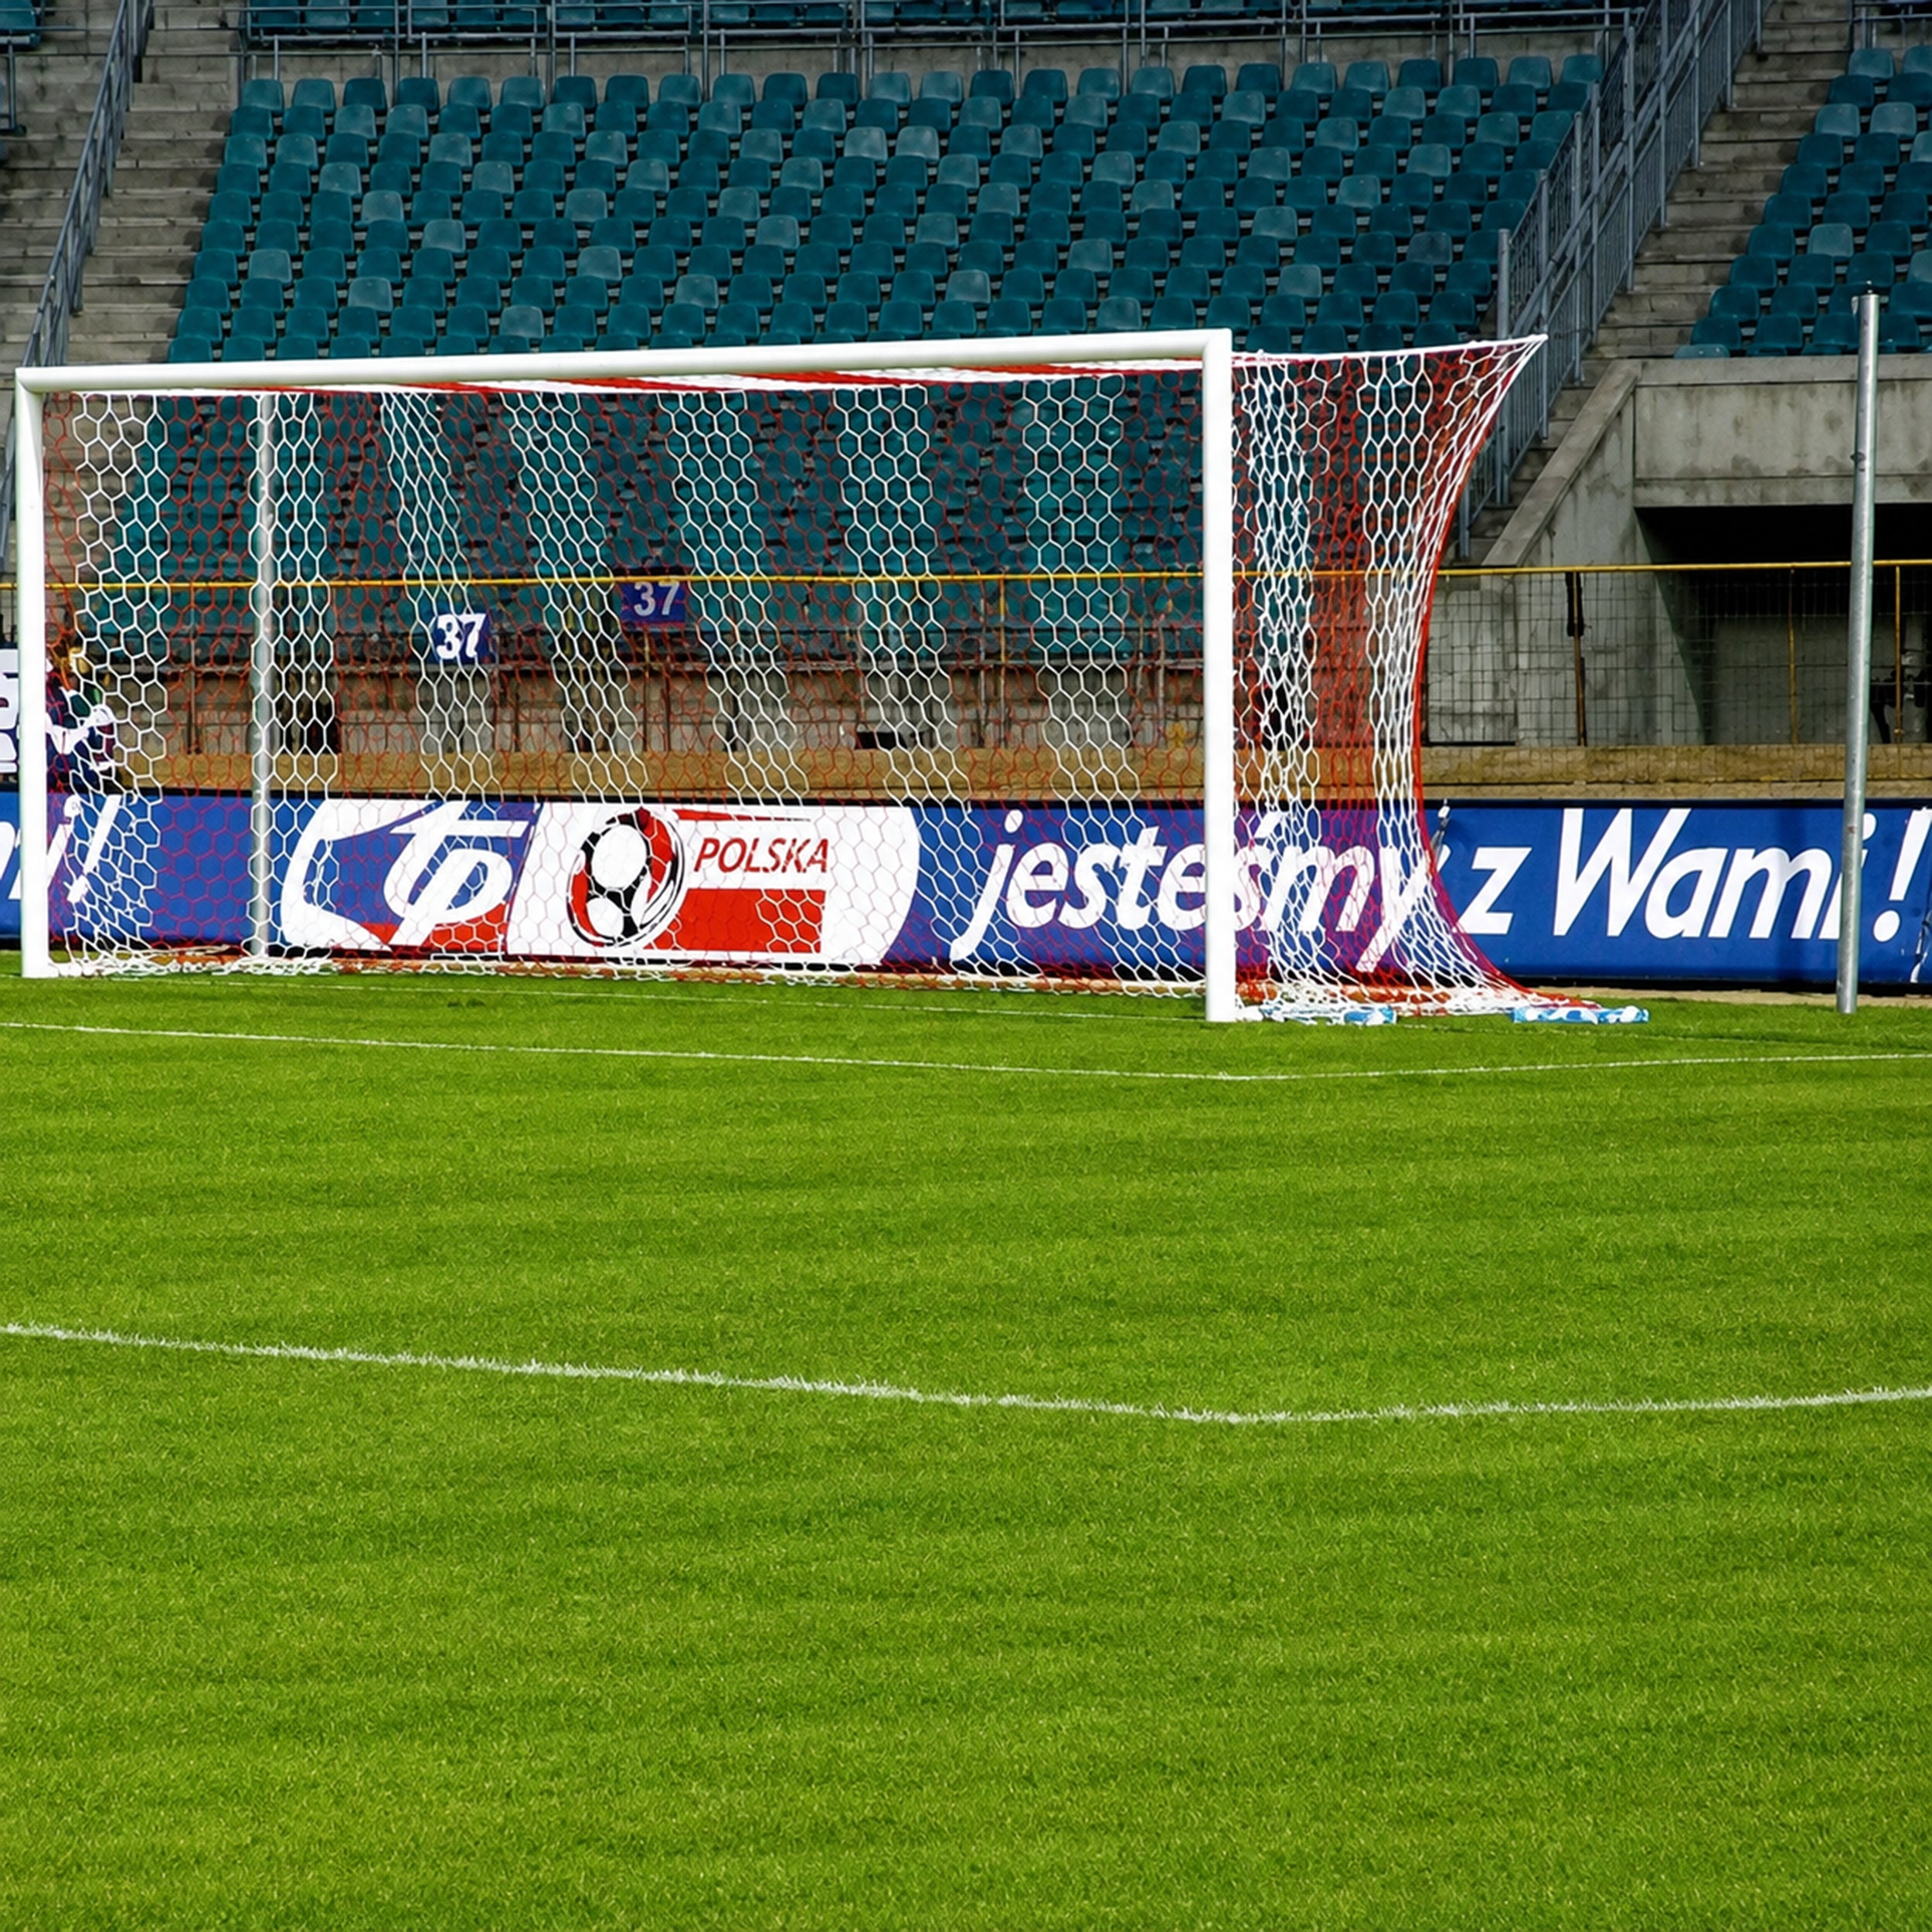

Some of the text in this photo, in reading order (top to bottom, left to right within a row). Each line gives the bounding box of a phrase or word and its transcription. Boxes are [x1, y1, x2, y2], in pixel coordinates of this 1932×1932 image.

[634, 582, 680, 616] 37
[437, 613, 485, 659] 37
[694, 837, 828, 873] POLSKA
[1458, 847, 1532, 934] z
